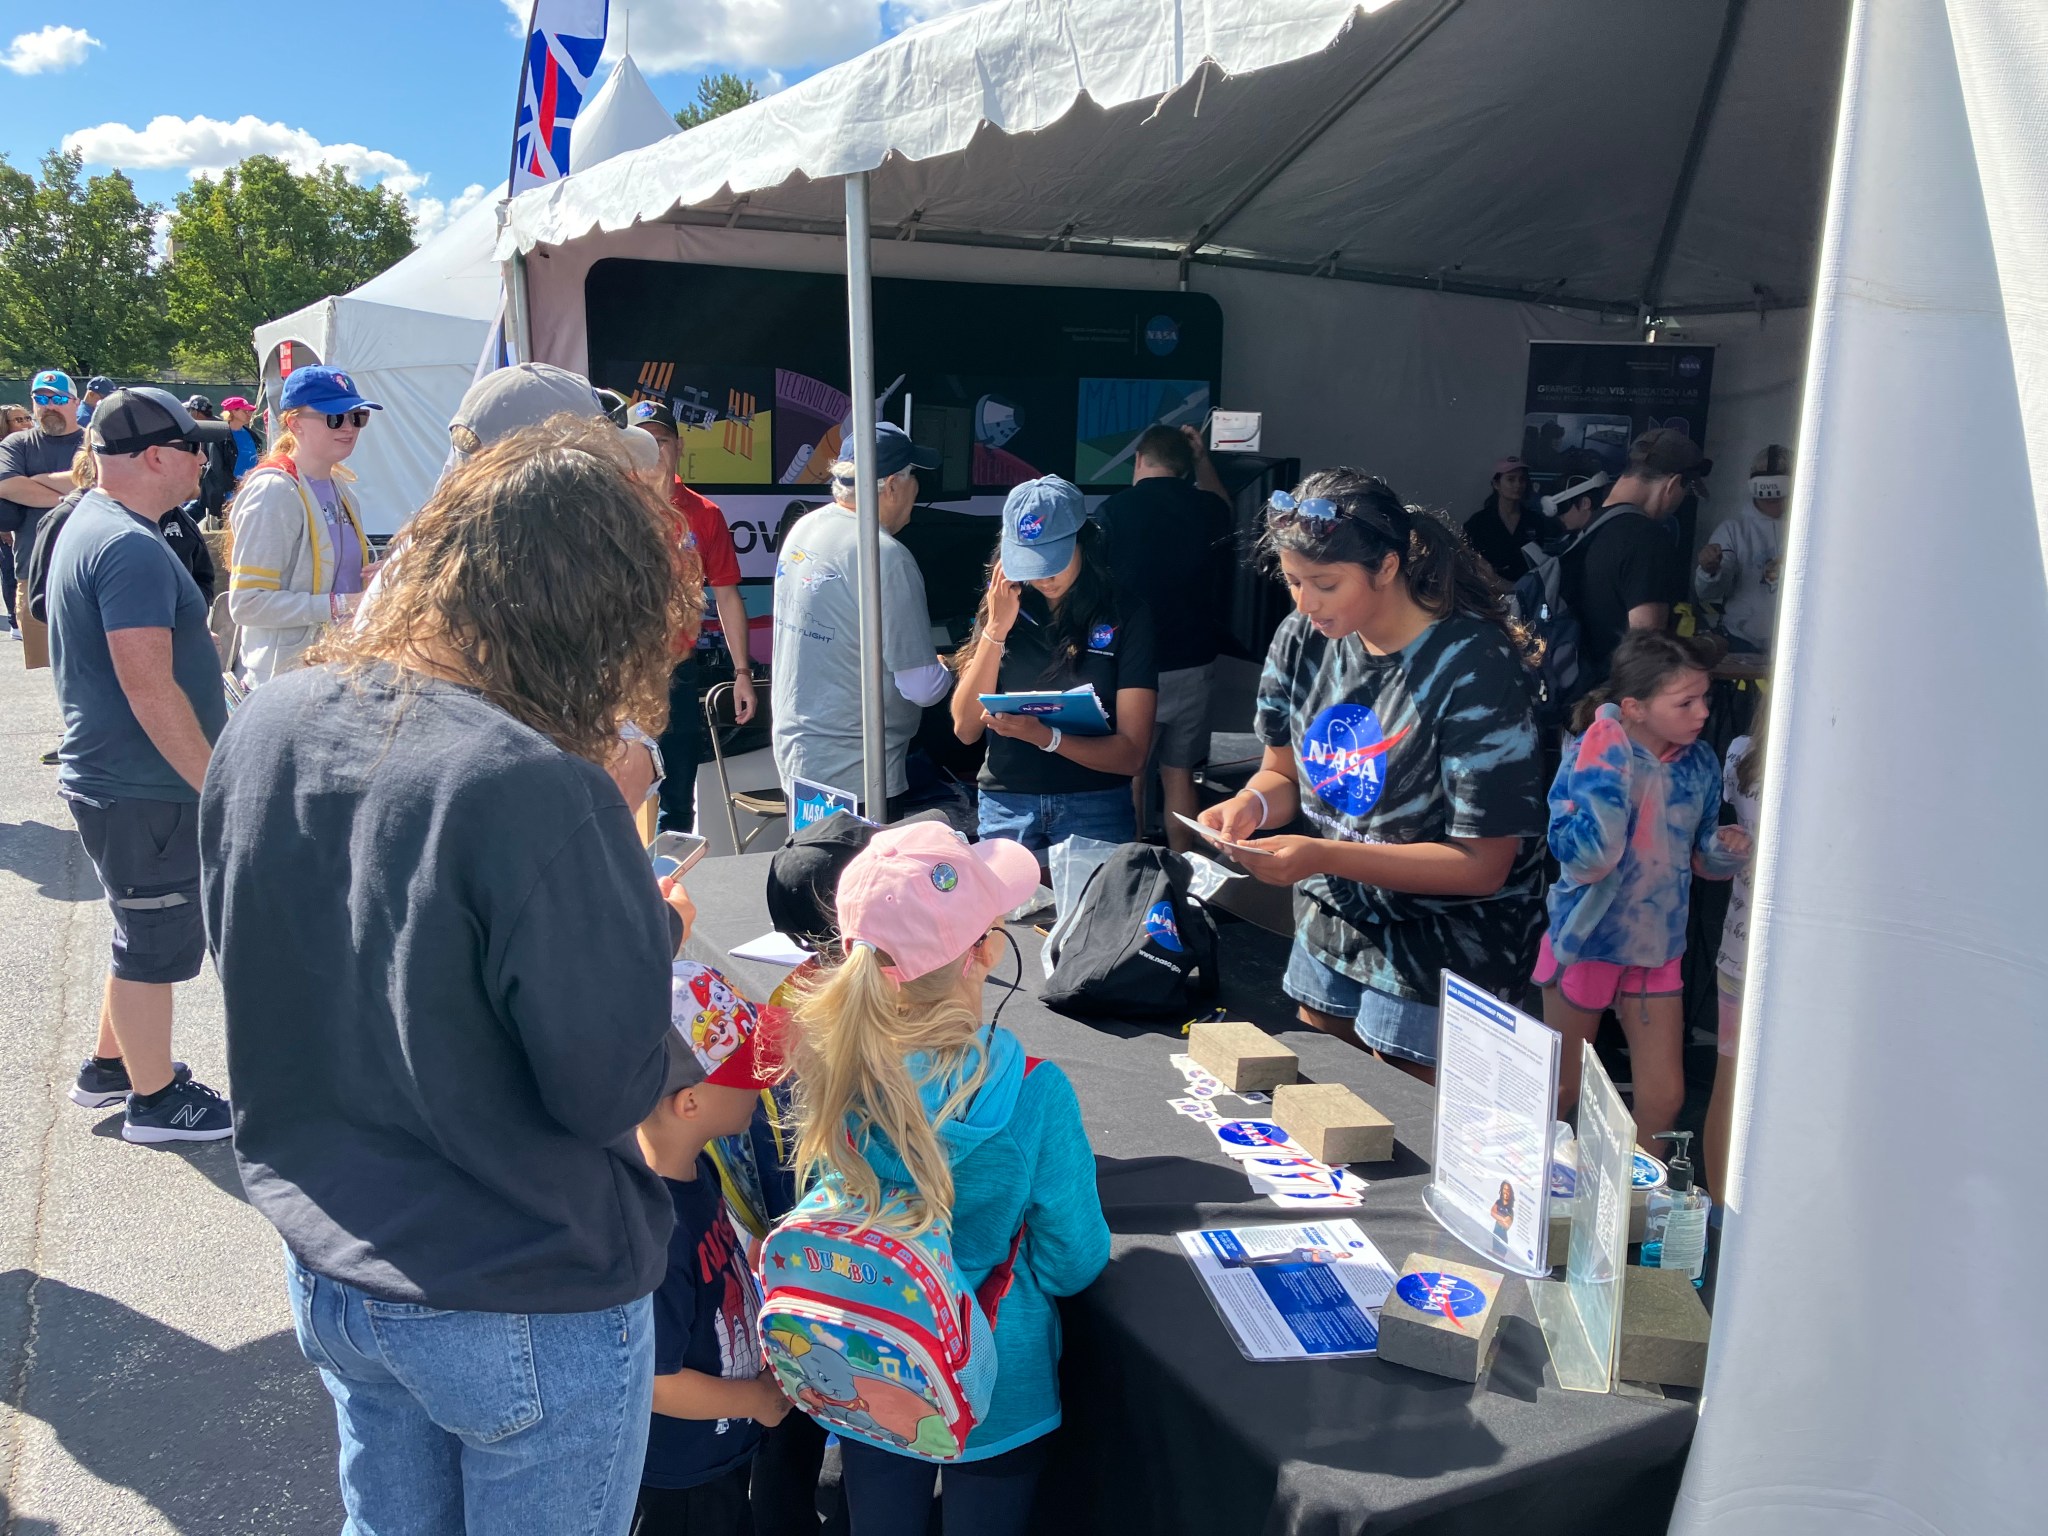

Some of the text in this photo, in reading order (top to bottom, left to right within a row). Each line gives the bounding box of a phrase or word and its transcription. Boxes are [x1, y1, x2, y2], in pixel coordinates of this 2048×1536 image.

[1146, 330, 1178, 341] NASA
[779, 370, 852, 420] TECHNOLOGY
[1084, 380, 1151, 440] MATH
[1020, 522, 1042, 532] NASA
[1307, 739, 1380, 785] NASA
[802, 802, 825, 822] NASA
[1326, 815, 1364, 841] Research
[803, 1246, 878, 1285] DUMBO
[1422, 1275, 1458, 1311] NASA
